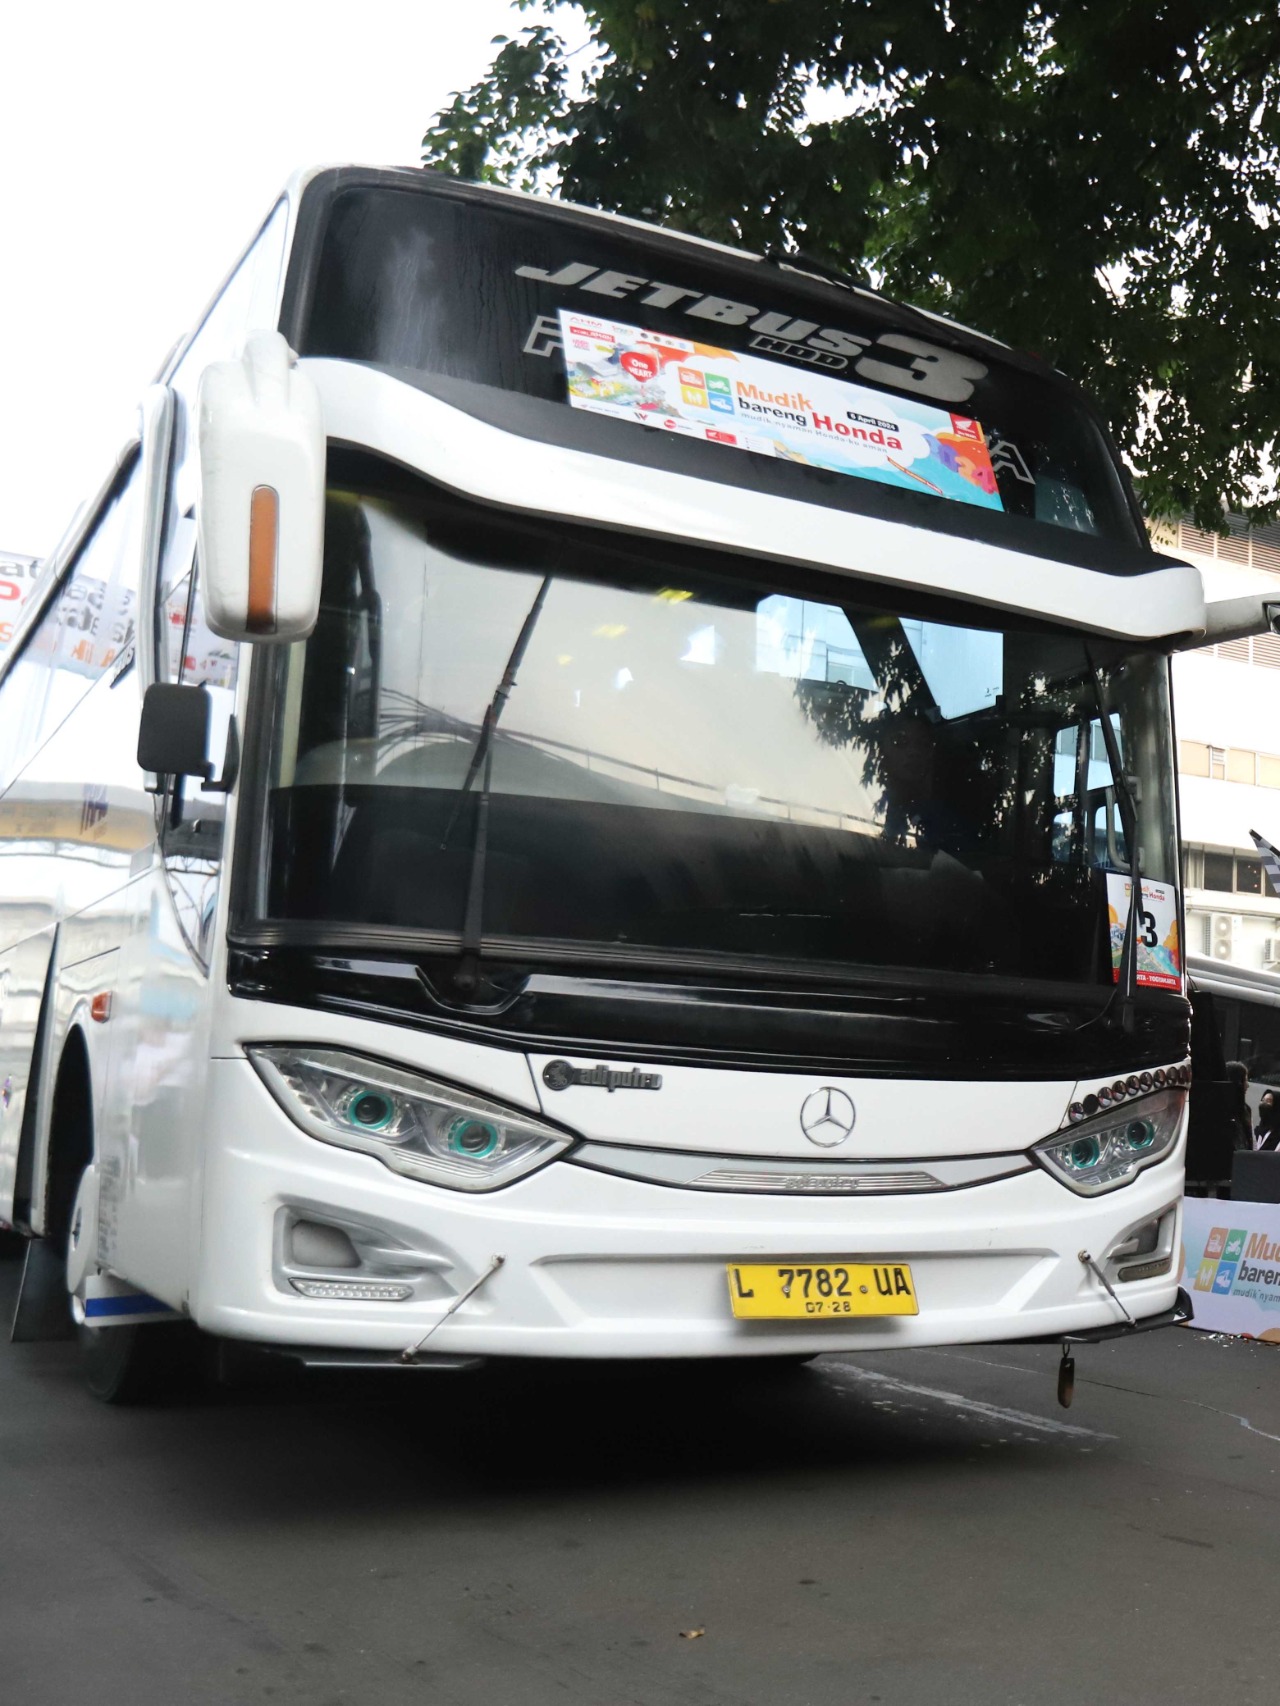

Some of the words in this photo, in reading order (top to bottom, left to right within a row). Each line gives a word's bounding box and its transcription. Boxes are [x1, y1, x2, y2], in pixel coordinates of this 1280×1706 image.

[631, 359, 649, 370] One
[749, 335, 848, 369] HDD
[628, 367, 653, 378] HEART
[736, 381, 813, 411] Mudik
[738, 397, 807, 427] bareng
[812, 412, 903, 450] Honda
[1138, 911, 1158, 947] 3
[735, 1268, 755, 1298] L
[778, 1268, 852, 1298] 7782
[873, 1267, 911, 1295] UA
[1232, 1287, 1257, 1299] mudik
